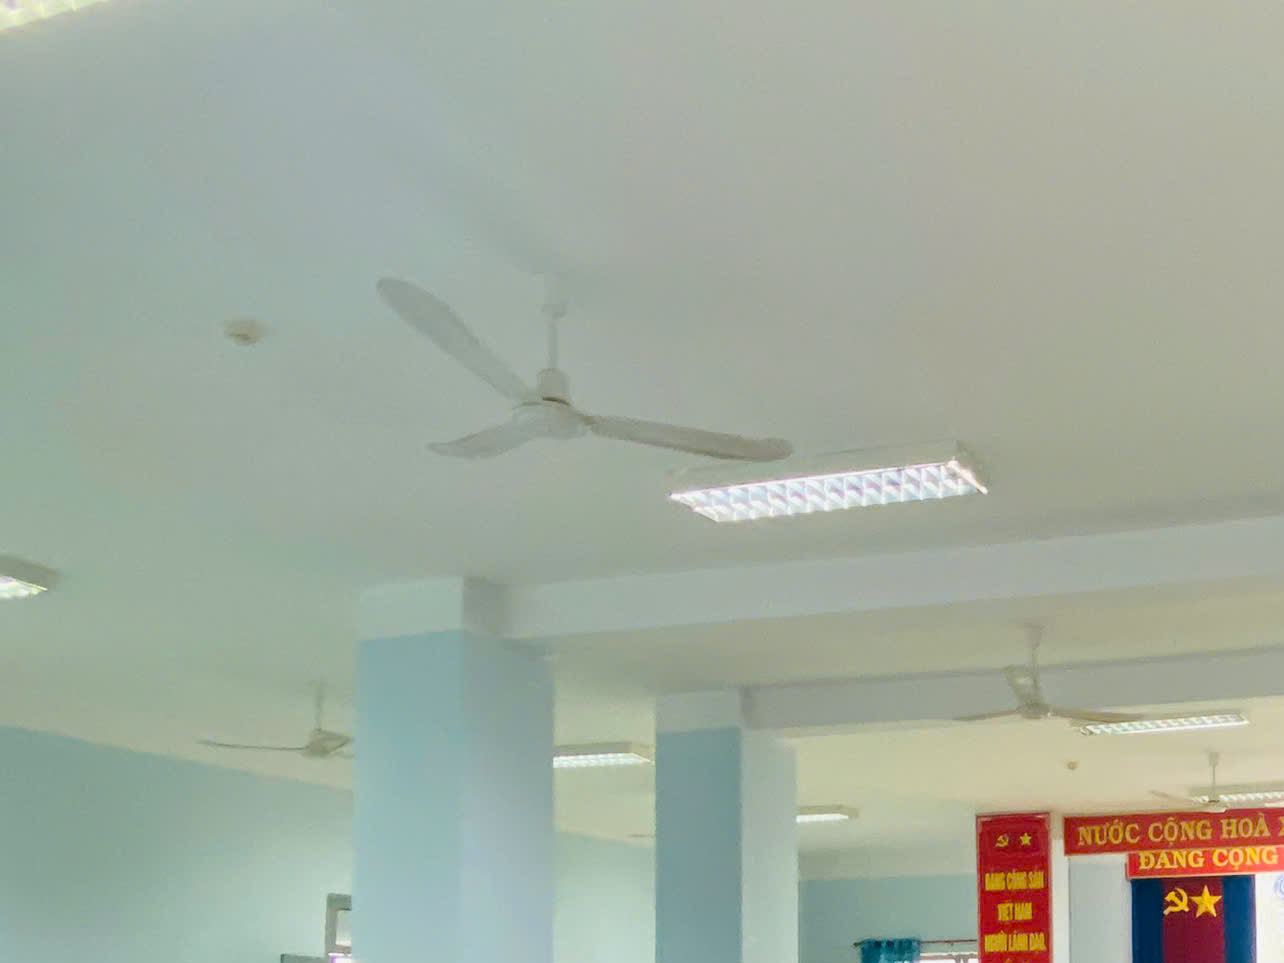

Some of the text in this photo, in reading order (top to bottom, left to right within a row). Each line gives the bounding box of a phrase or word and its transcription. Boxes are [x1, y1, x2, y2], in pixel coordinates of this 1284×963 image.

[1078, 818, 1140, 846] NƯỚC
[1148, 817, 1212, 848] CỘNG
[1221, 812, 1271, 839] HOÀ
